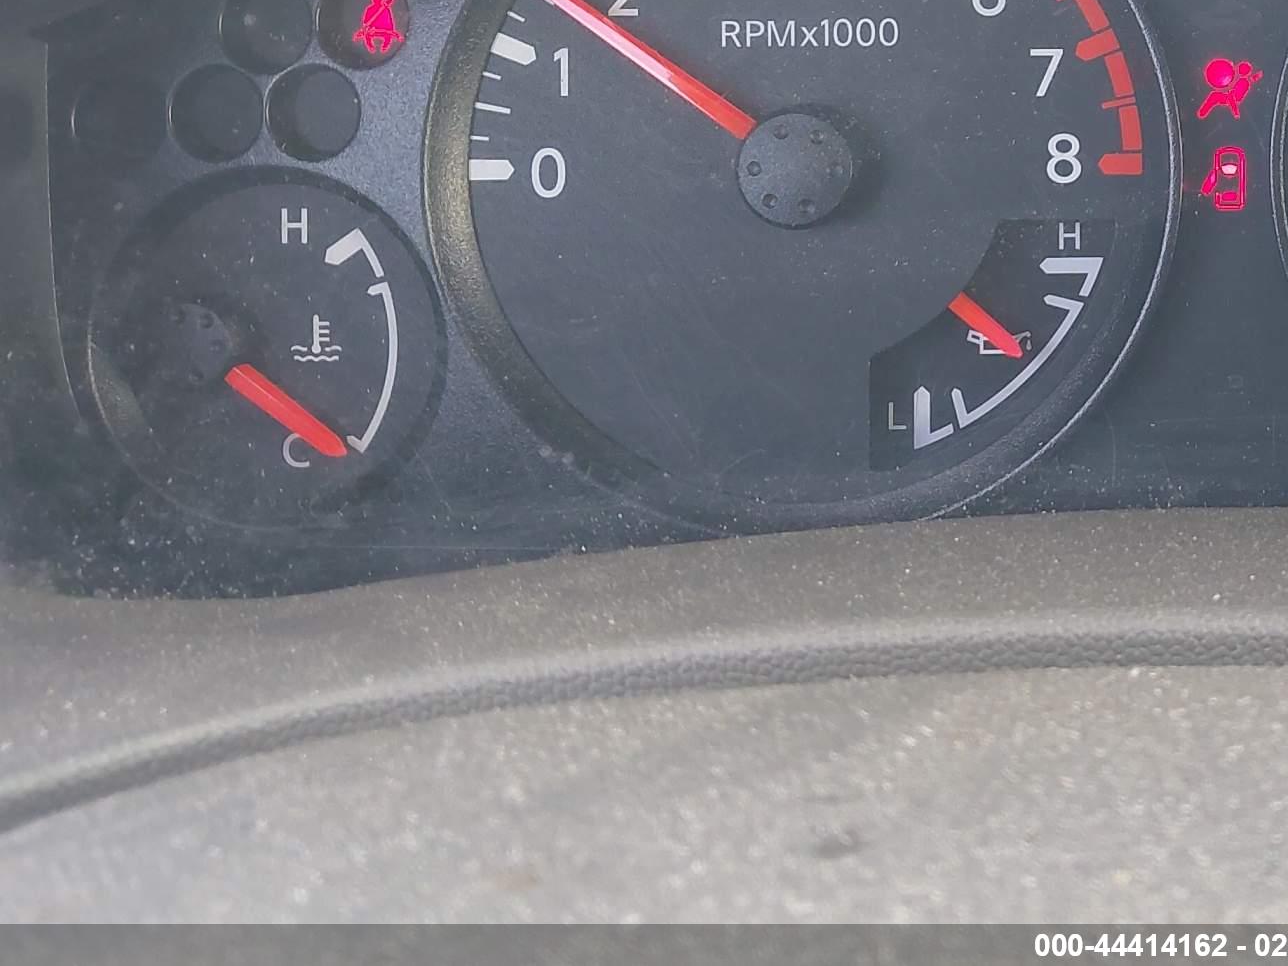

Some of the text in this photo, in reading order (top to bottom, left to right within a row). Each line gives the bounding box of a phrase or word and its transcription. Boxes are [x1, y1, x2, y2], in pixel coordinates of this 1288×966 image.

[720, 17, 900, 48] RPMx1000
[552, 49, 571, 97] 1
[1029, 48, 1063, 97] 7
[530, 147, 567, 198] 0
[1046, 134, 1082, 184] 8
[281, 208, 308, 244] H
[1058, 222, 1081, 250] H
[888, 401, 907, 430] L
[283, 434, 310, 468] C
